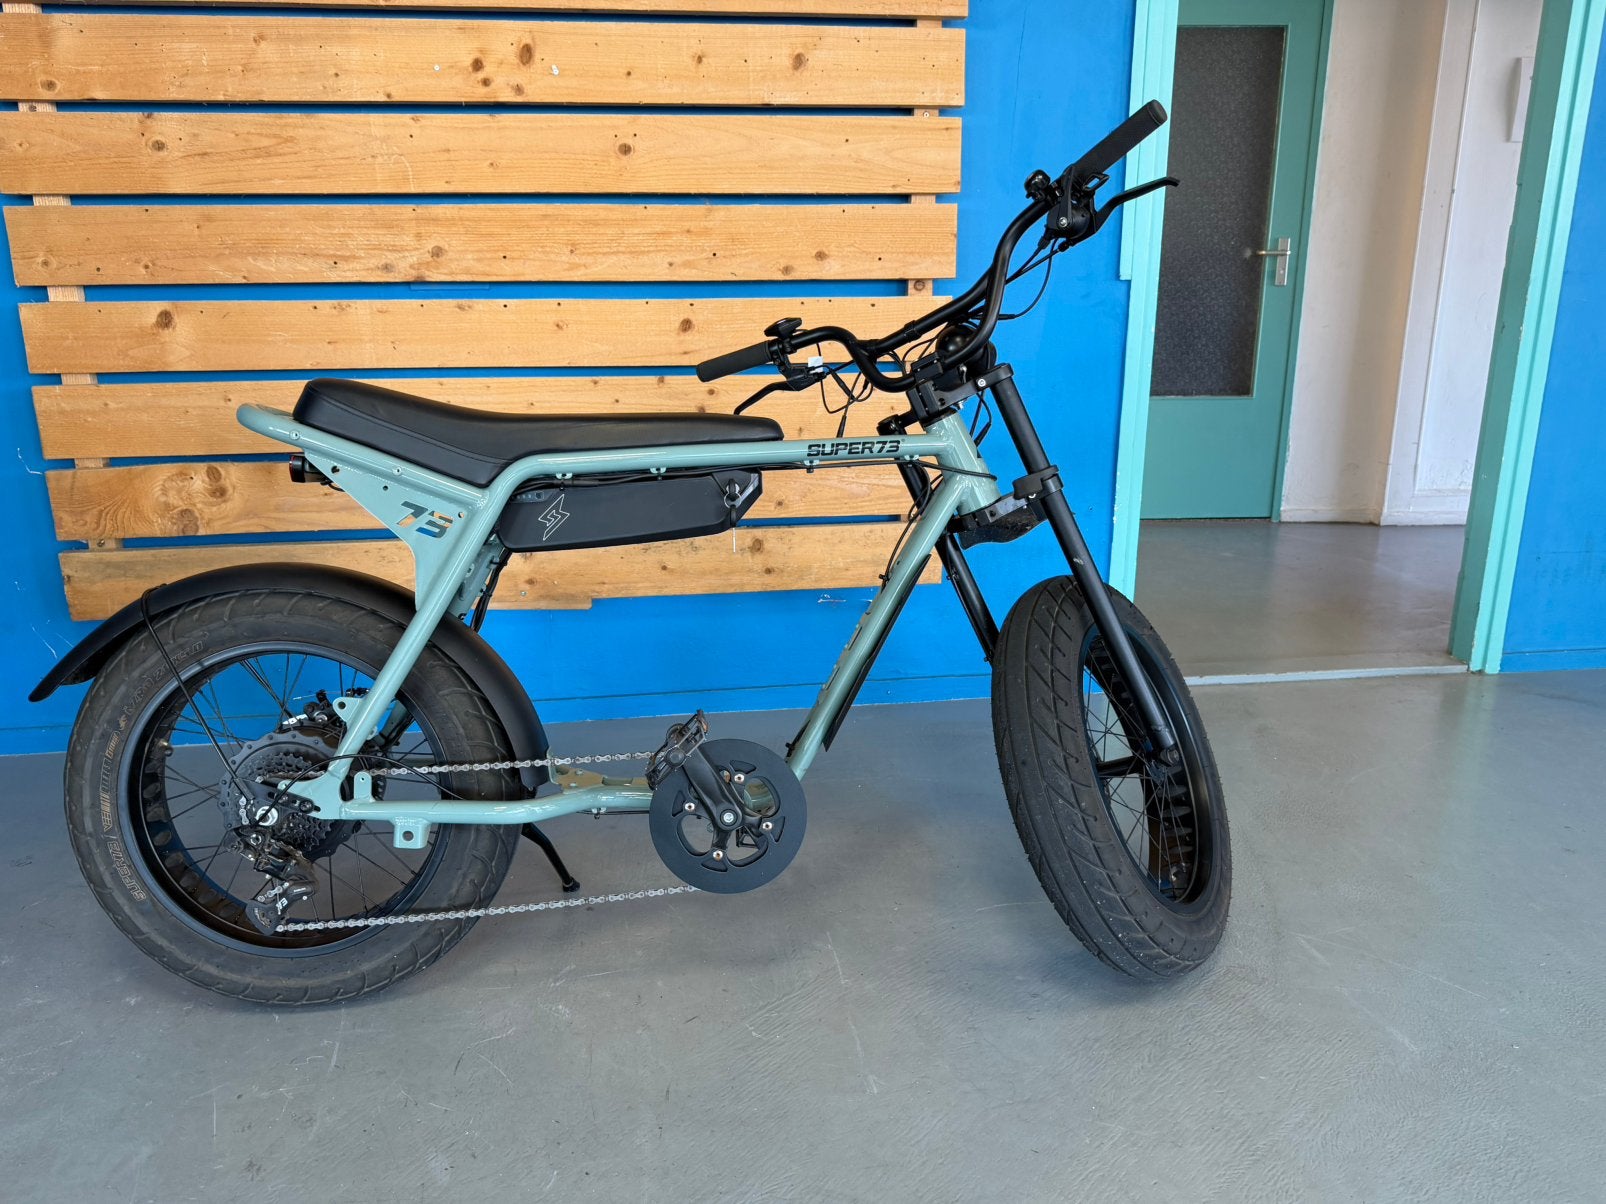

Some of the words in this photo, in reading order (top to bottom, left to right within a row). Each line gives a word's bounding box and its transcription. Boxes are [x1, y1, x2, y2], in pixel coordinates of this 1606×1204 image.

[807, 440, 901, 457] SUPER73
[396, 500, 453, 538] 73
[107, 841, 146, 901] SUPER73
